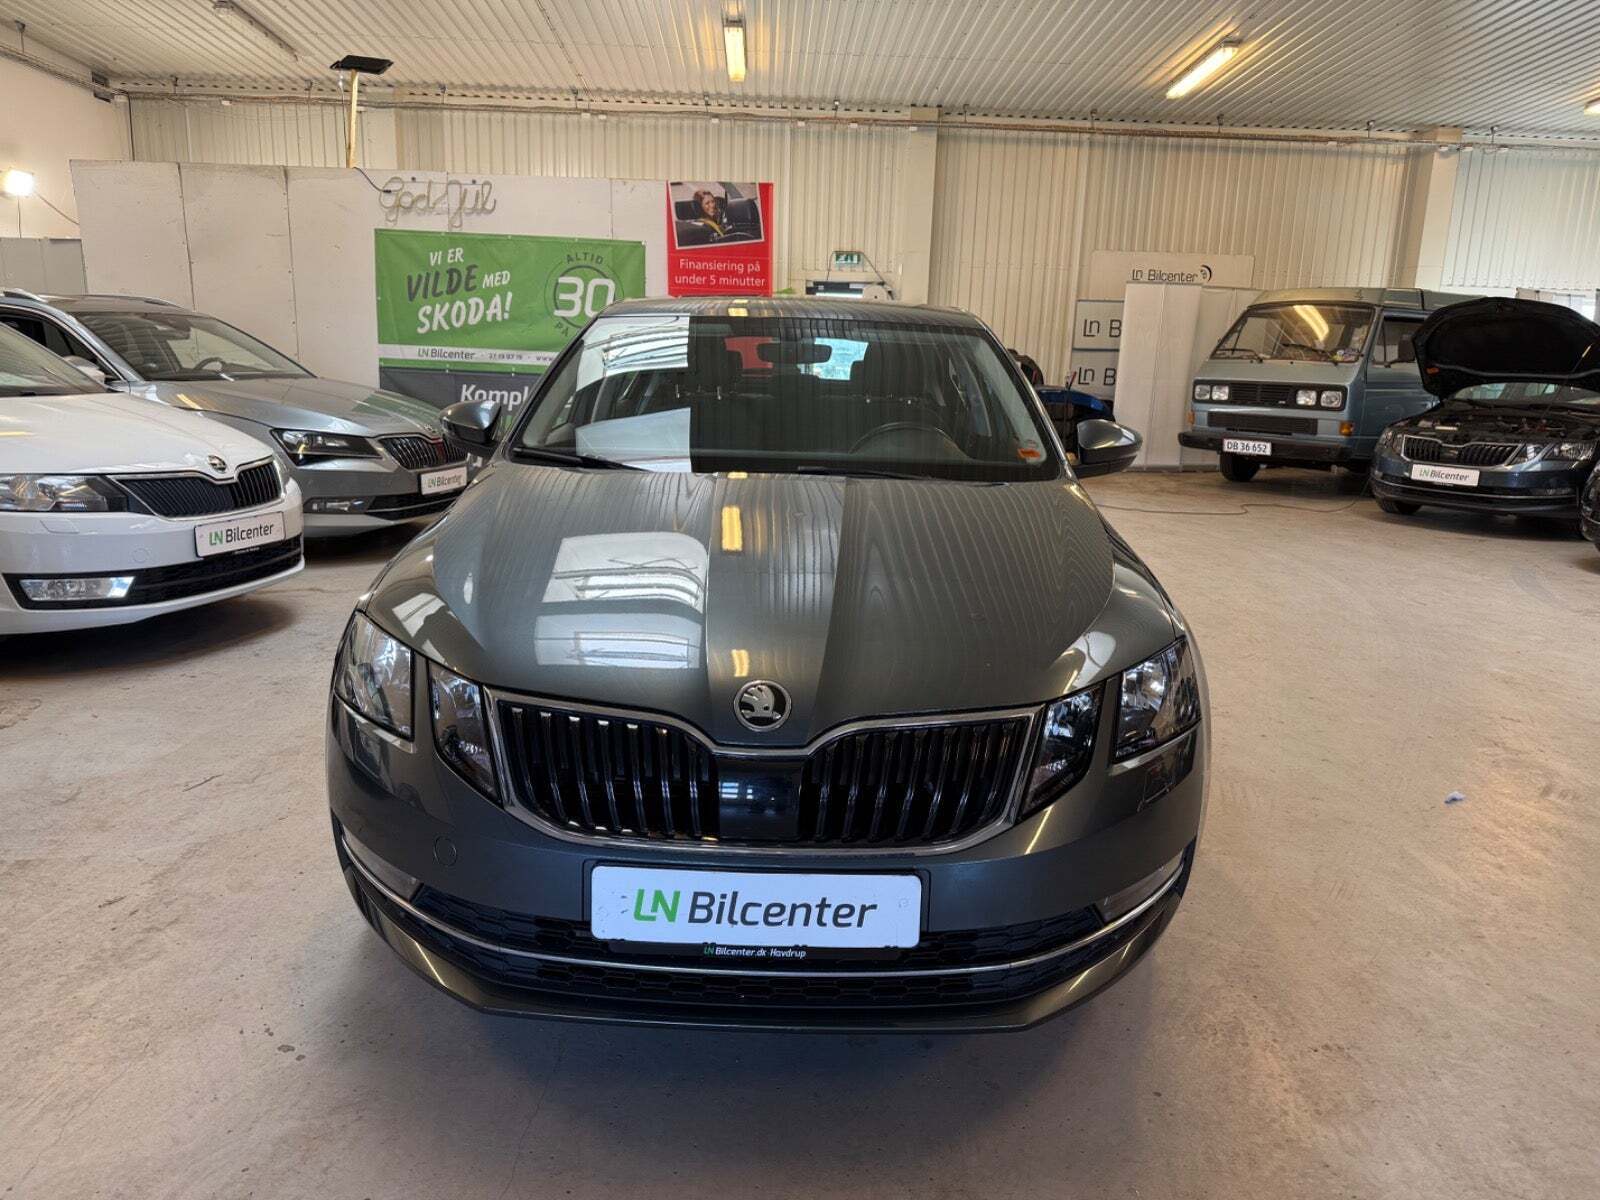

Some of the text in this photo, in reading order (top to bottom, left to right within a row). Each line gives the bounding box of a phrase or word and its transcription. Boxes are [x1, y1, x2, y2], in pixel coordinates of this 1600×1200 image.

[429, 248, 465, 266] VI ER
[566, 251, 604, 265] ALTID
[679, 258, 761, 274] Finansiering på
[406, 264, 511, 302] VILDE MED
[675, 274, 766, 287] under 5 minutter
[1147, 269, 1199, 283] Bilcenter
[553, 276, 616, 318] 30
[416, 291, 513, 334] SKODA!
[1109, 319, 1122, 337] B
[431, 348, 476, 360] Bilcenter
[1103, 367, 1116, 386] B
[461, 383, 529, 412] Kompl
[436, 474, 464, 487] Bilcenter
[1430, 469, 1470, 482] Bilcenter
[209, 523, 274, 546] LN Bilcenter
[633, 888, 878, 929] LN Bilcenter
[715, 946, 766, 957] Bilcenter.dk
[770, 947, 806, 959] Havdrup
